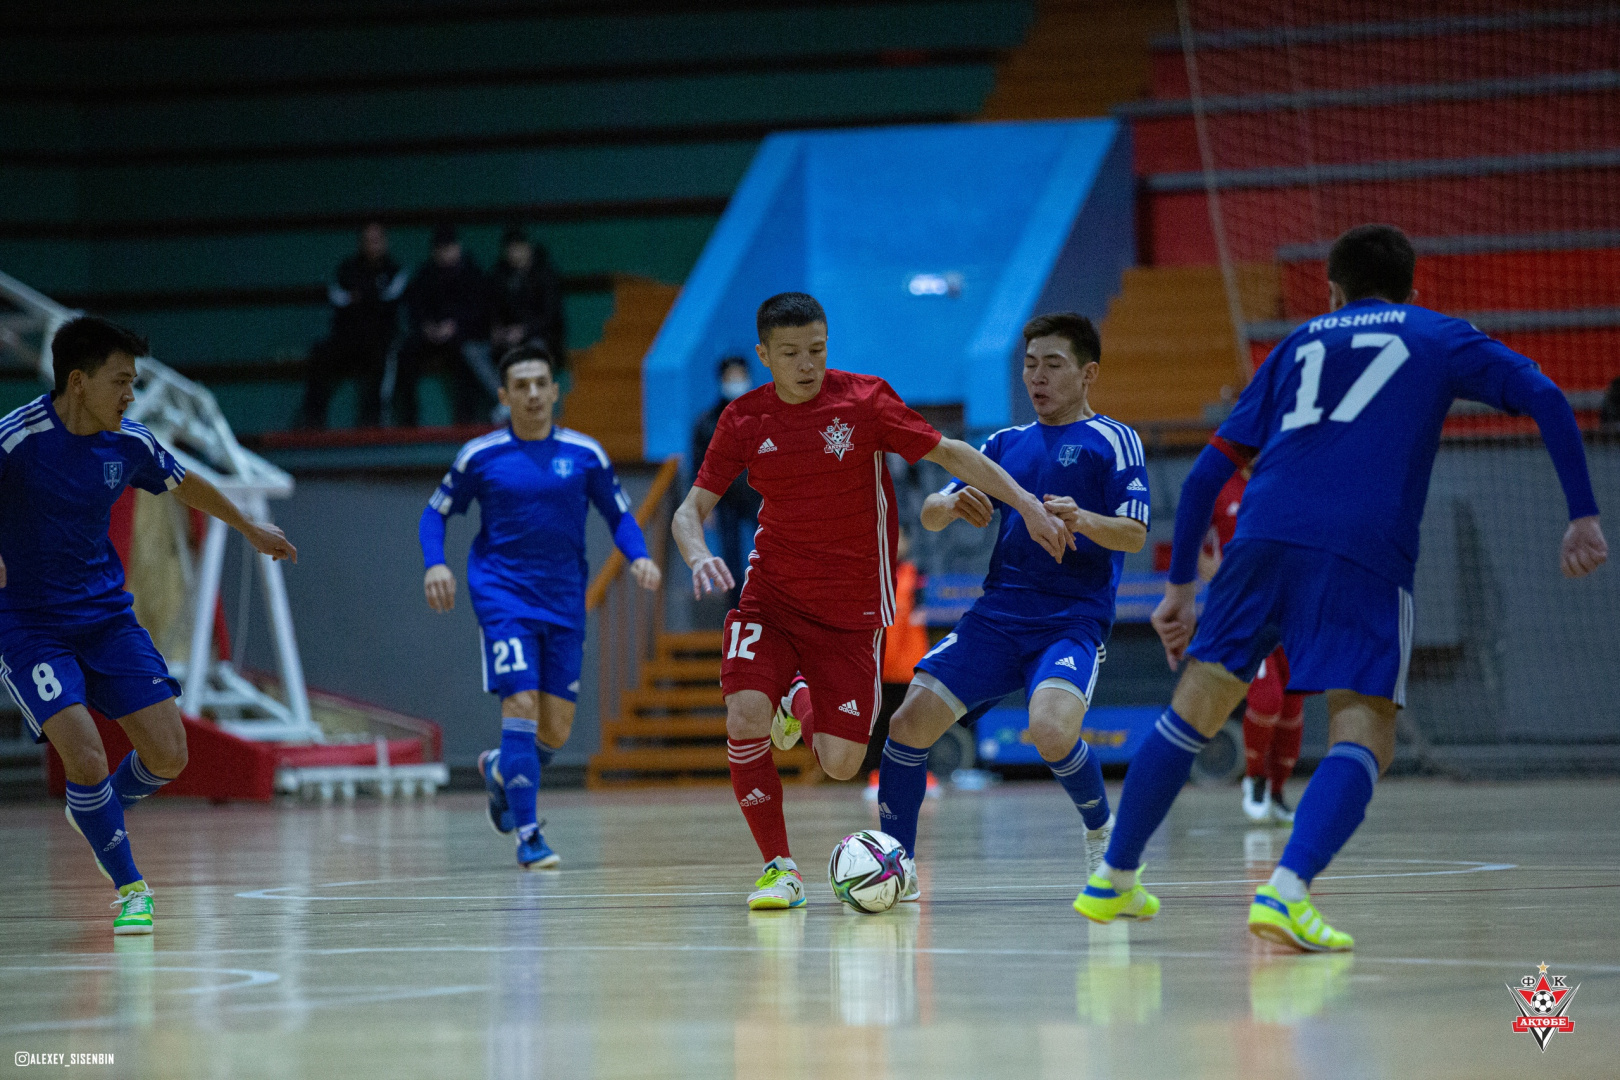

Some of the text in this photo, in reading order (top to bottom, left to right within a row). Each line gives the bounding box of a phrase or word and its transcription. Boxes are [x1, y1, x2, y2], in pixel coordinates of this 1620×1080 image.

[1308, 310, 1407, 334] KOSHKIN
[1280, 333, 1411, 432] 17
[758, 446, 778, 454] adidas
[727, 621, 763, 660] 12
[492, 637, 528, 675] 21
[1055, 661, 1077, 671] adidas
[31, 662, 63, 702] 8
[838, 705, 860, 717] adidas
[739, 794, 771, 807] adidas
[879, 811, 898, 820] das
